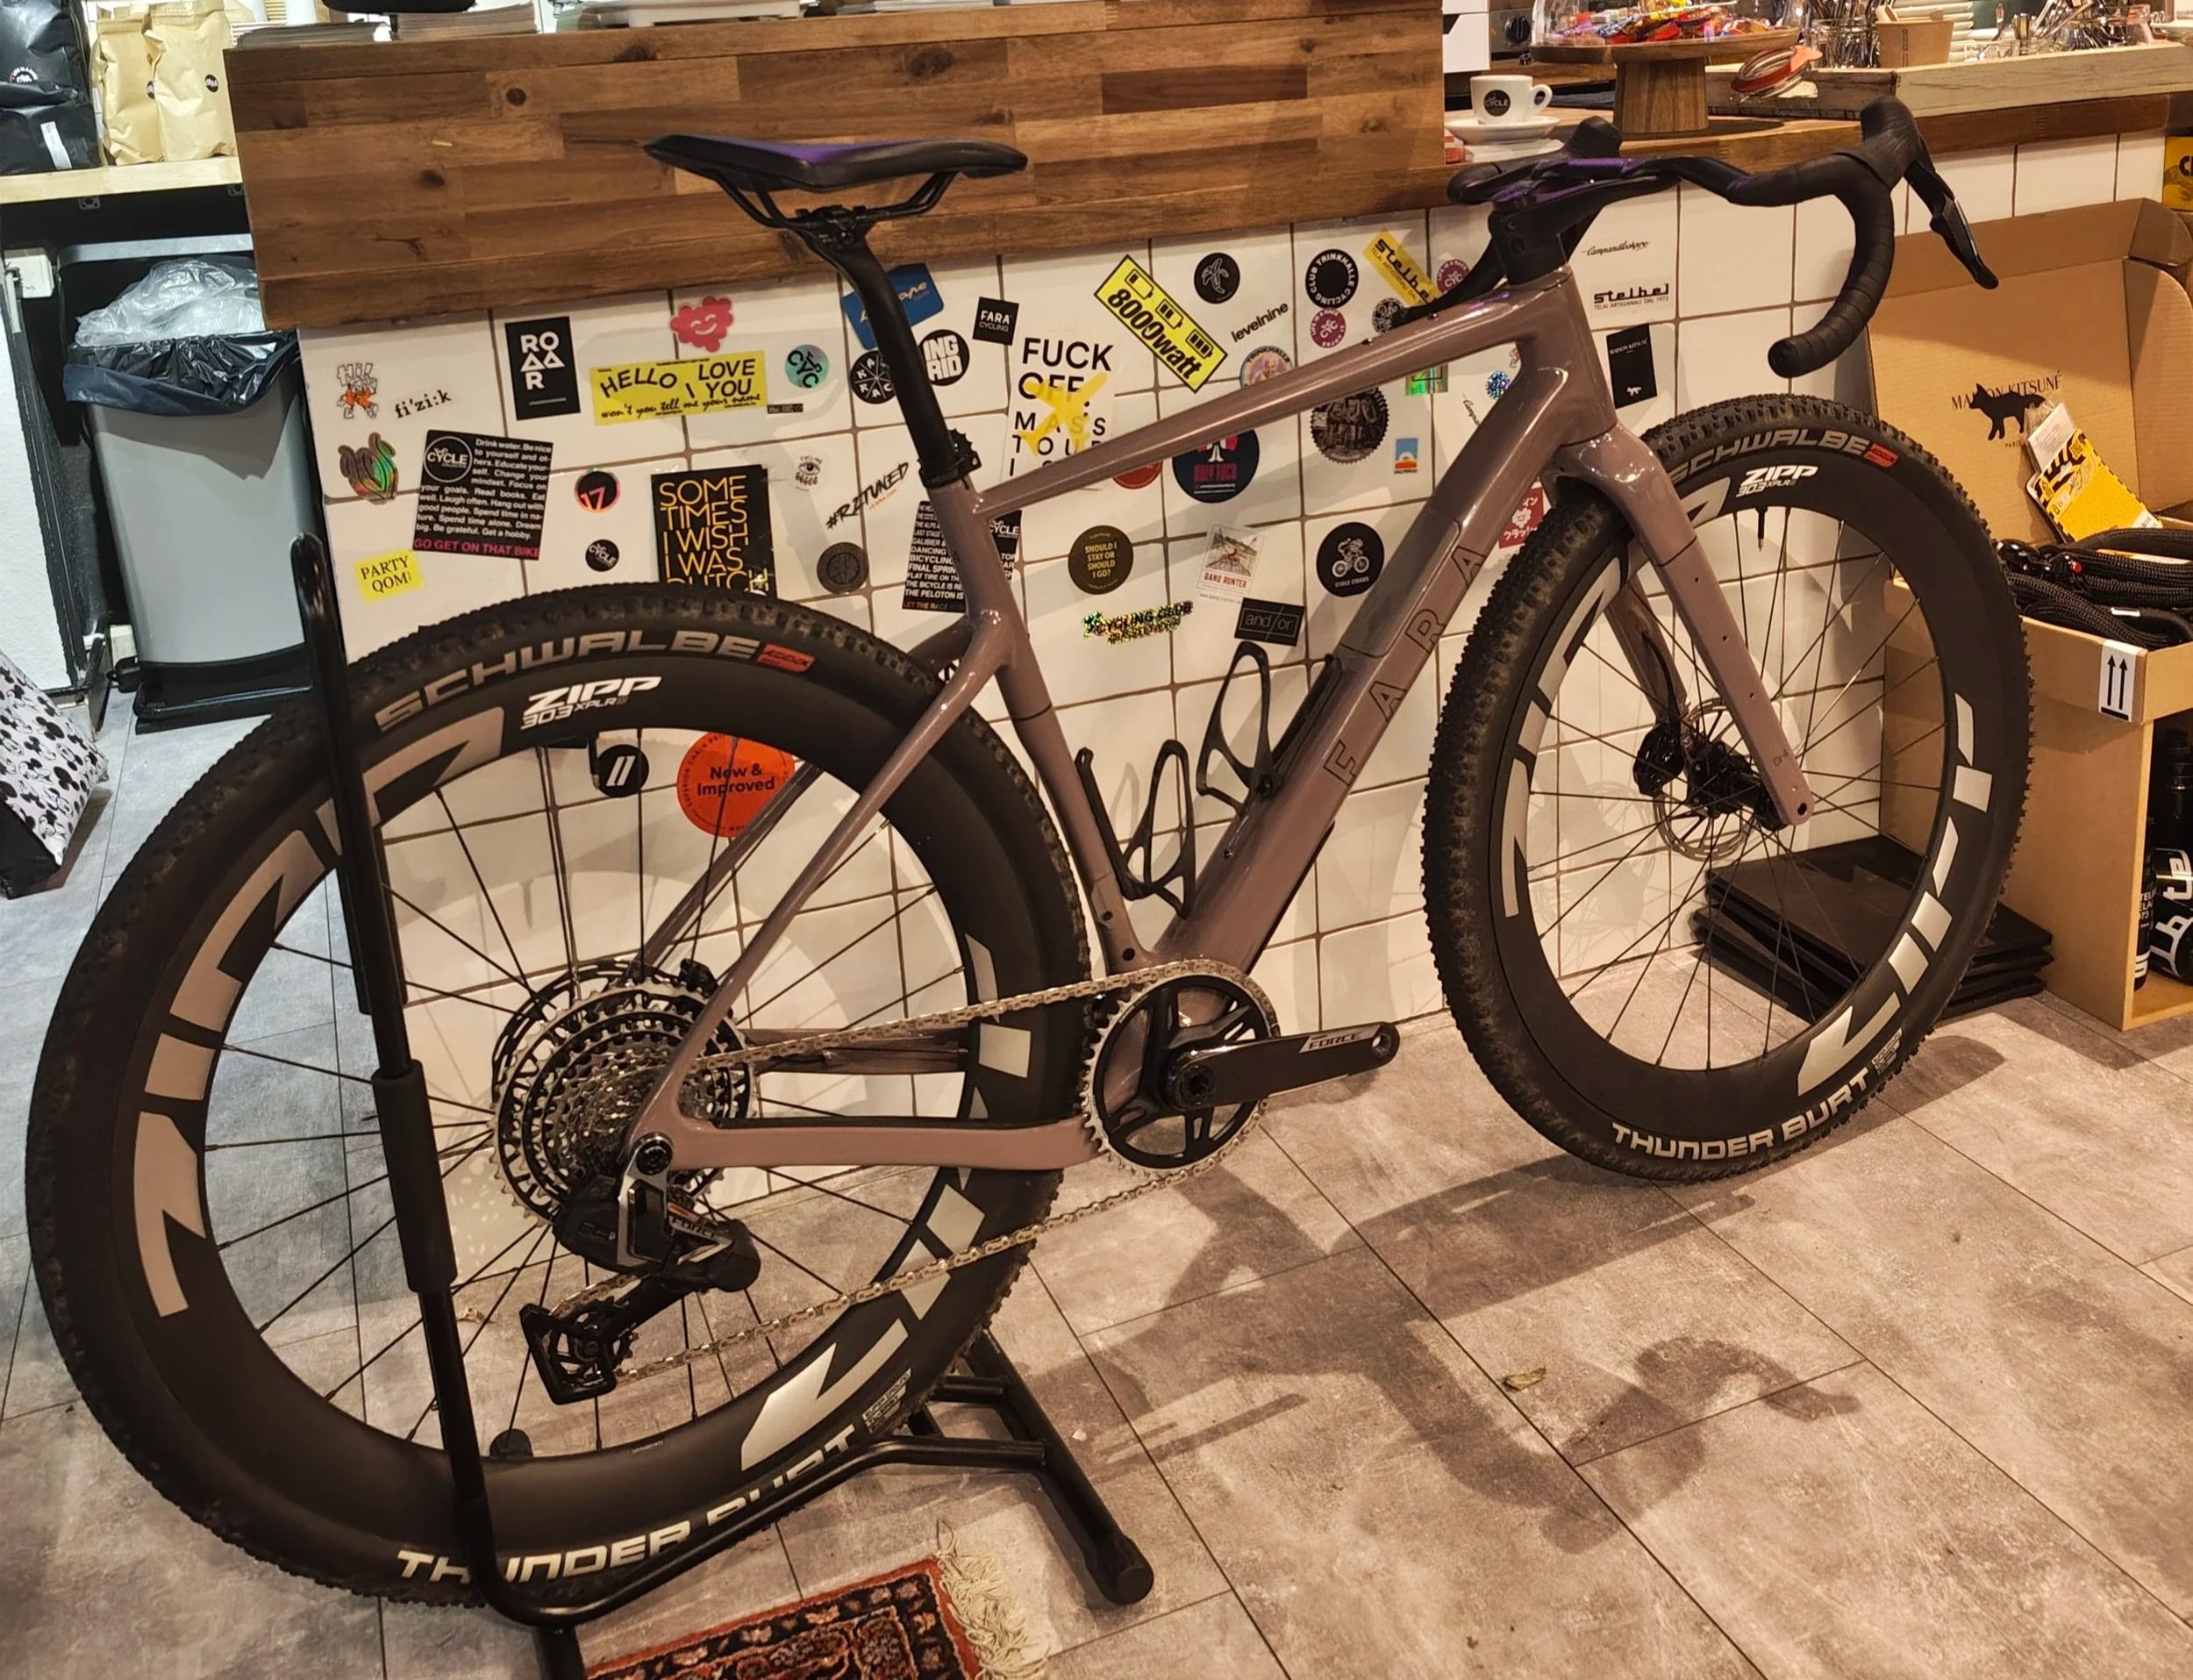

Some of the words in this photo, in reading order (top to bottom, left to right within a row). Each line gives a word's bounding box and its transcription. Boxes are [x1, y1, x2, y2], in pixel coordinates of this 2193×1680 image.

[1375, 239, 1437, 303] Stelbe
[1309, 268, 1318, 293] CLUB
[1316, 289, 1351, 305] CYCLING
[981, 310, 1011, 325] FARA
[1232, 303, 1289, 342] levelnine
[979, 322, 1009, 332] CYCLING
[1108, 289, 1202, 379] 8000watt
[923, 334, 959, 361] ING
[1022, 337, 1115, 371] FUCK
[698, 359, 755, 381] LOVE
[926, 354, 963, 382] RID
[600, 368, 677, 398] HELLO
[685, 382, 695, 398] I
[706, 378, 752, 398] YOU
[661, 398, 680, 410] tell
[1952, 388, 2004, 410] MAON
[475, 439, 497, 447] Drink
[1011, 434, 1102, 456] TOU
[427, 452, 468, 465] CYCLE
[486, 450, 518, 459] yourself
[1667, 429, 1870, 484] SCHWALBE
[495, 461, 527, 469] Educate
[494, 470, 525, 480] Change
[1739, 465, 1818, 486] ZIPP
[474, 488, 496, 497] Read
[500, 490, 526, 499] books.
[509, 480, 533, 490] Focus
[660, 475, 748, 507] SOME
[1735, 480, 1768, 498] 303
[439, 495, 465, 504] Laugh
[467, 497, 489, 506] often.
[490, 500, 511, 510] Hang
[441, 506, 471, 515] people.
[473, 507, 499, 518] Spend
[660, 499, 748, 531] TIMES
[439, 515, 465, 524] Spend
[468, 517, 486, 525] time
[516, 521, 541, 530] Dream
[989, 525, 1019, 535] YCLE
[446, 525, 480, 534] grateful.
[504, 530, 532, 540] hobby.
[663, 531, 669, 554] I
[676, 523, 749, 553] WISH
[414, 539, 432, 548] GO
[434, 540, 460, 550] GET
[461, 542, 479, 552] ON
[482, 544, 511, 554] THAT
[911, 546, 946, 555] DANCING
[1085, 543, 1112, 554] SHOULD
[665, 554, 670, 579] I
[678, 547, 744, 576] WAS
[1087, 553, 1104, 562] STAY
[1104, 551, 1116, 560] OR
[1087, 560, 1116, 570] SHOULD
[361, 555, 408, 580] PARTY
[909, 563, 931, 572] FINAL
[932, 565, 956, 574] SPRIN
[1096, 569, 1111, 578] GO?
[919, 581, 946, 590] BICYCLE
[921, 590, 955, 598] PELOTON
[956, 591, 964, 600] IS
[1245, 611, 1293, 634] and/or
[1323, 546, 1489, 788] FARA
[375, 629, 761, 733] SCHWALBE
[523, 676, 662, 716] ZIPP
[520, 704, 574, 730] 303
[751, 763, 762, 776] &
[696, 776, 775, 797] Improved
[1309, 1032, 1361, 1048] FORCE
[1611, 1121, 1775, 1161] THUNDER
[1781, 1067, 1870, 1141] BURT
